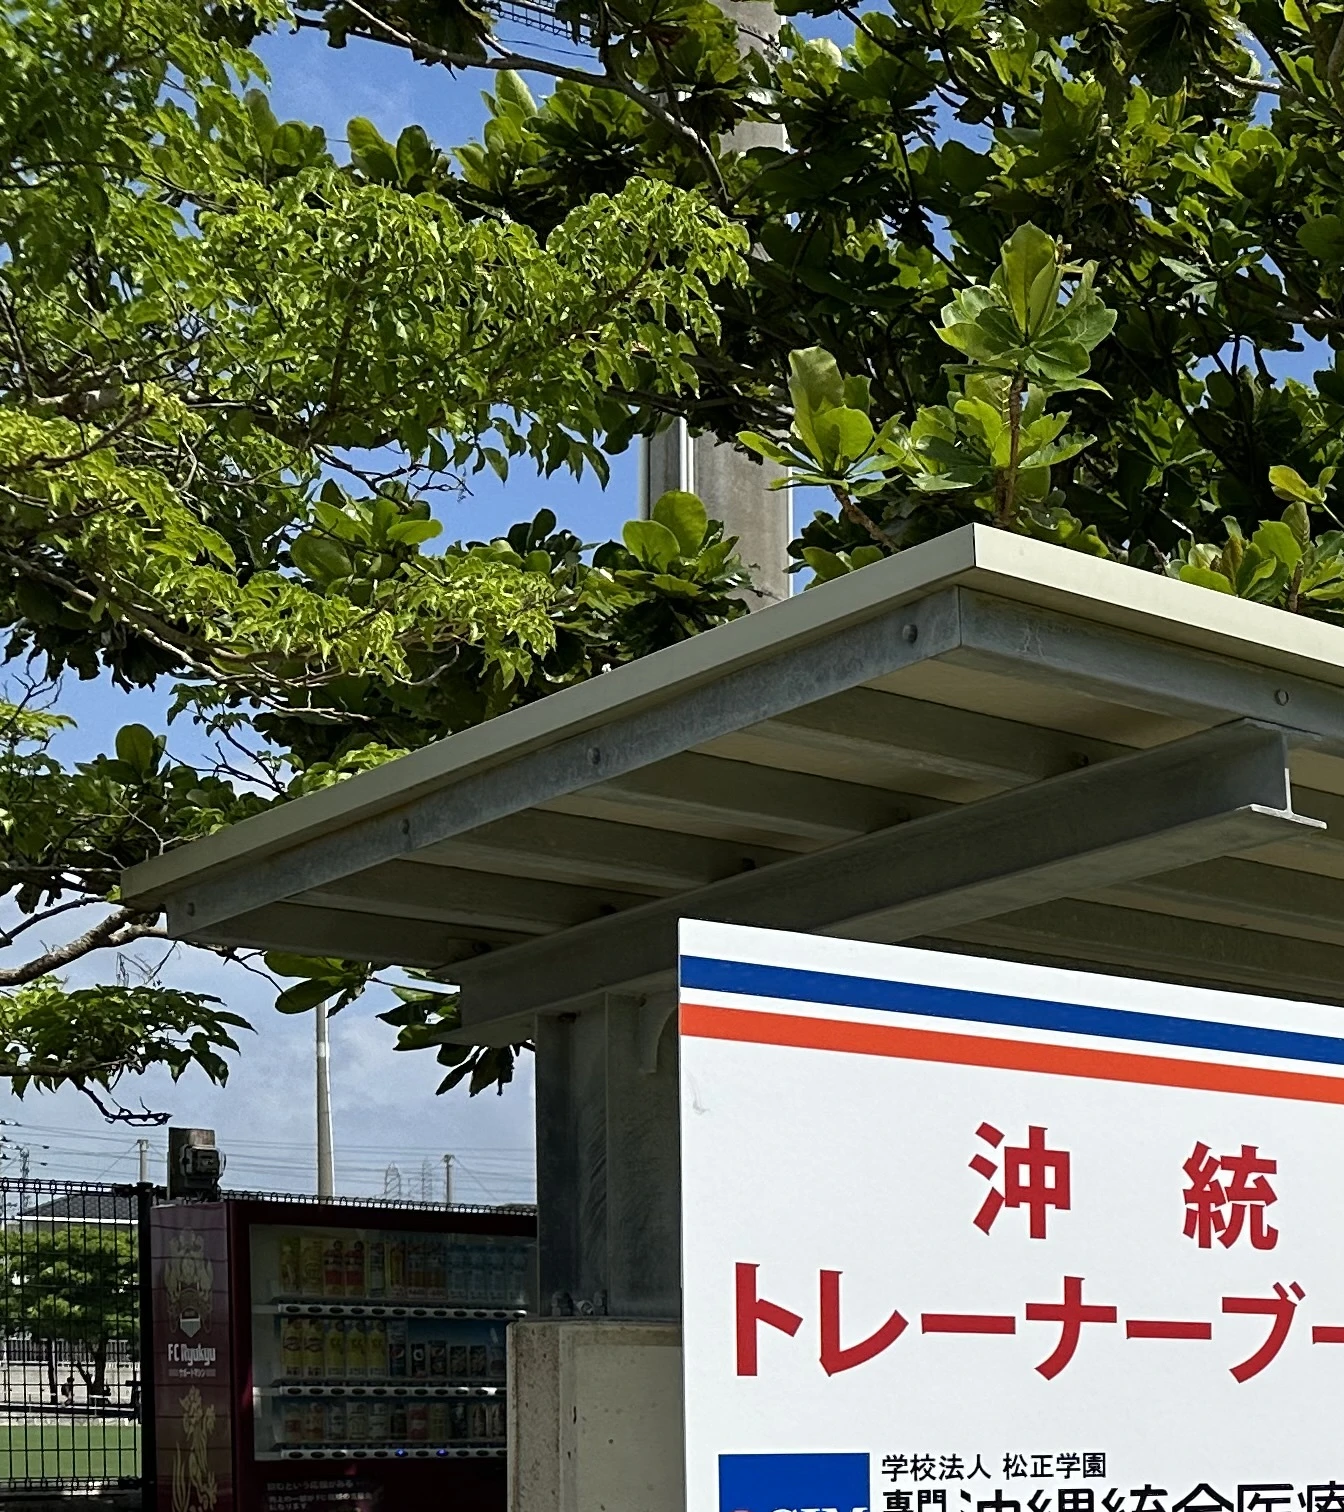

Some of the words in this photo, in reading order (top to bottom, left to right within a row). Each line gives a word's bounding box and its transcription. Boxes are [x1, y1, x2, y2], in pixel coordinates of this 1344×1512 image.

[167, 1343, 180, 1362] FC
[180, 1343, 216, 1366] Ryukyu
[881, 1453, 992, 1483] 学校法人
[1002, 1452, 1107, 1481] 松正学園
